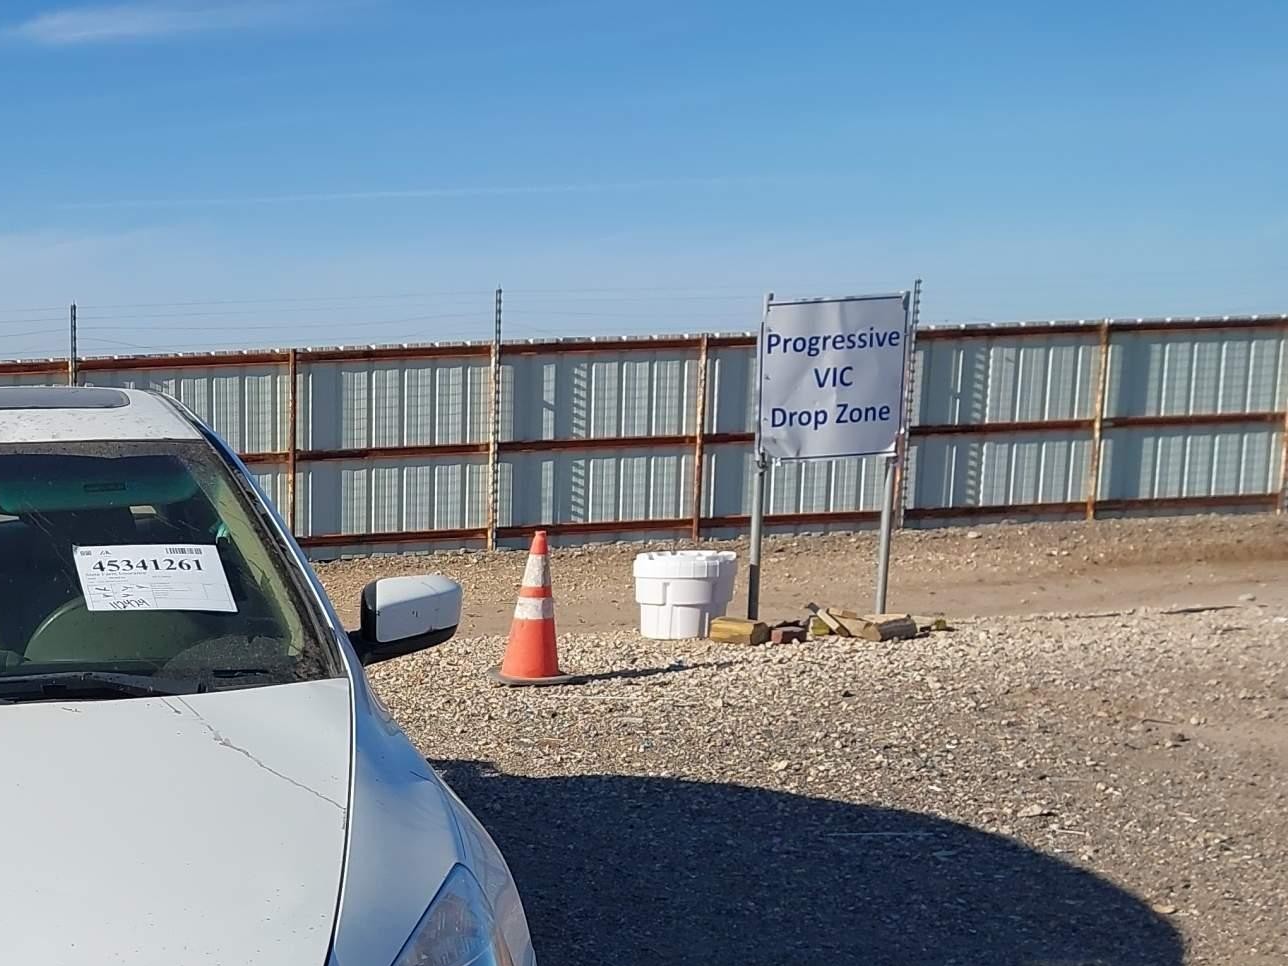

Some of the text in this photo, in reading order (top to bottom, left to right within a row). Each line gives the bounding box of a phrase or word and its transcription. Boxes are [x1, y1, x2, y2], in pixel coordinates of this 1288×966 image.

[767, 327, 900, 357] Progressive
[814, 366, 854, 388] VIC
[771, 403, 891, 430] Drop Zone
[92, 558, 203, 572] 45341261
